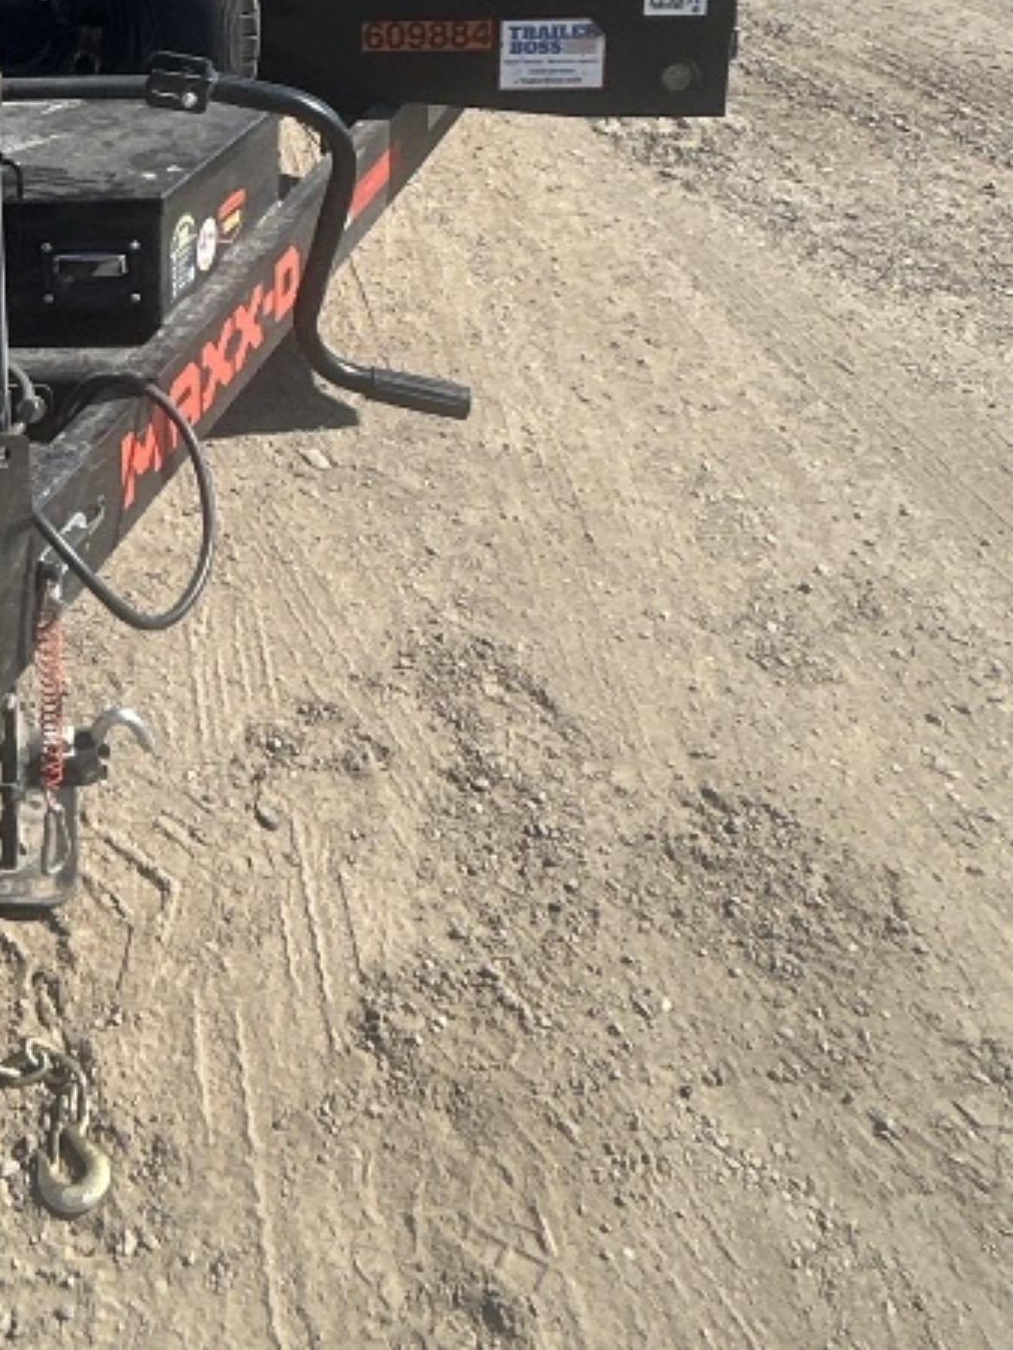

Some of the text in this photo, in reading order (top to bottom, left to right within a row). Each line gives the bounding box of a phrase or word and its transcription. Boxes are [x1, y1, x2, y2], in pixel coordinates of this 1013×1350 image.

[365, 20, 492, 49] 609884
[508, 40, 562, 55] BOSS
[121, 246, 300, 510] MAXX-D
